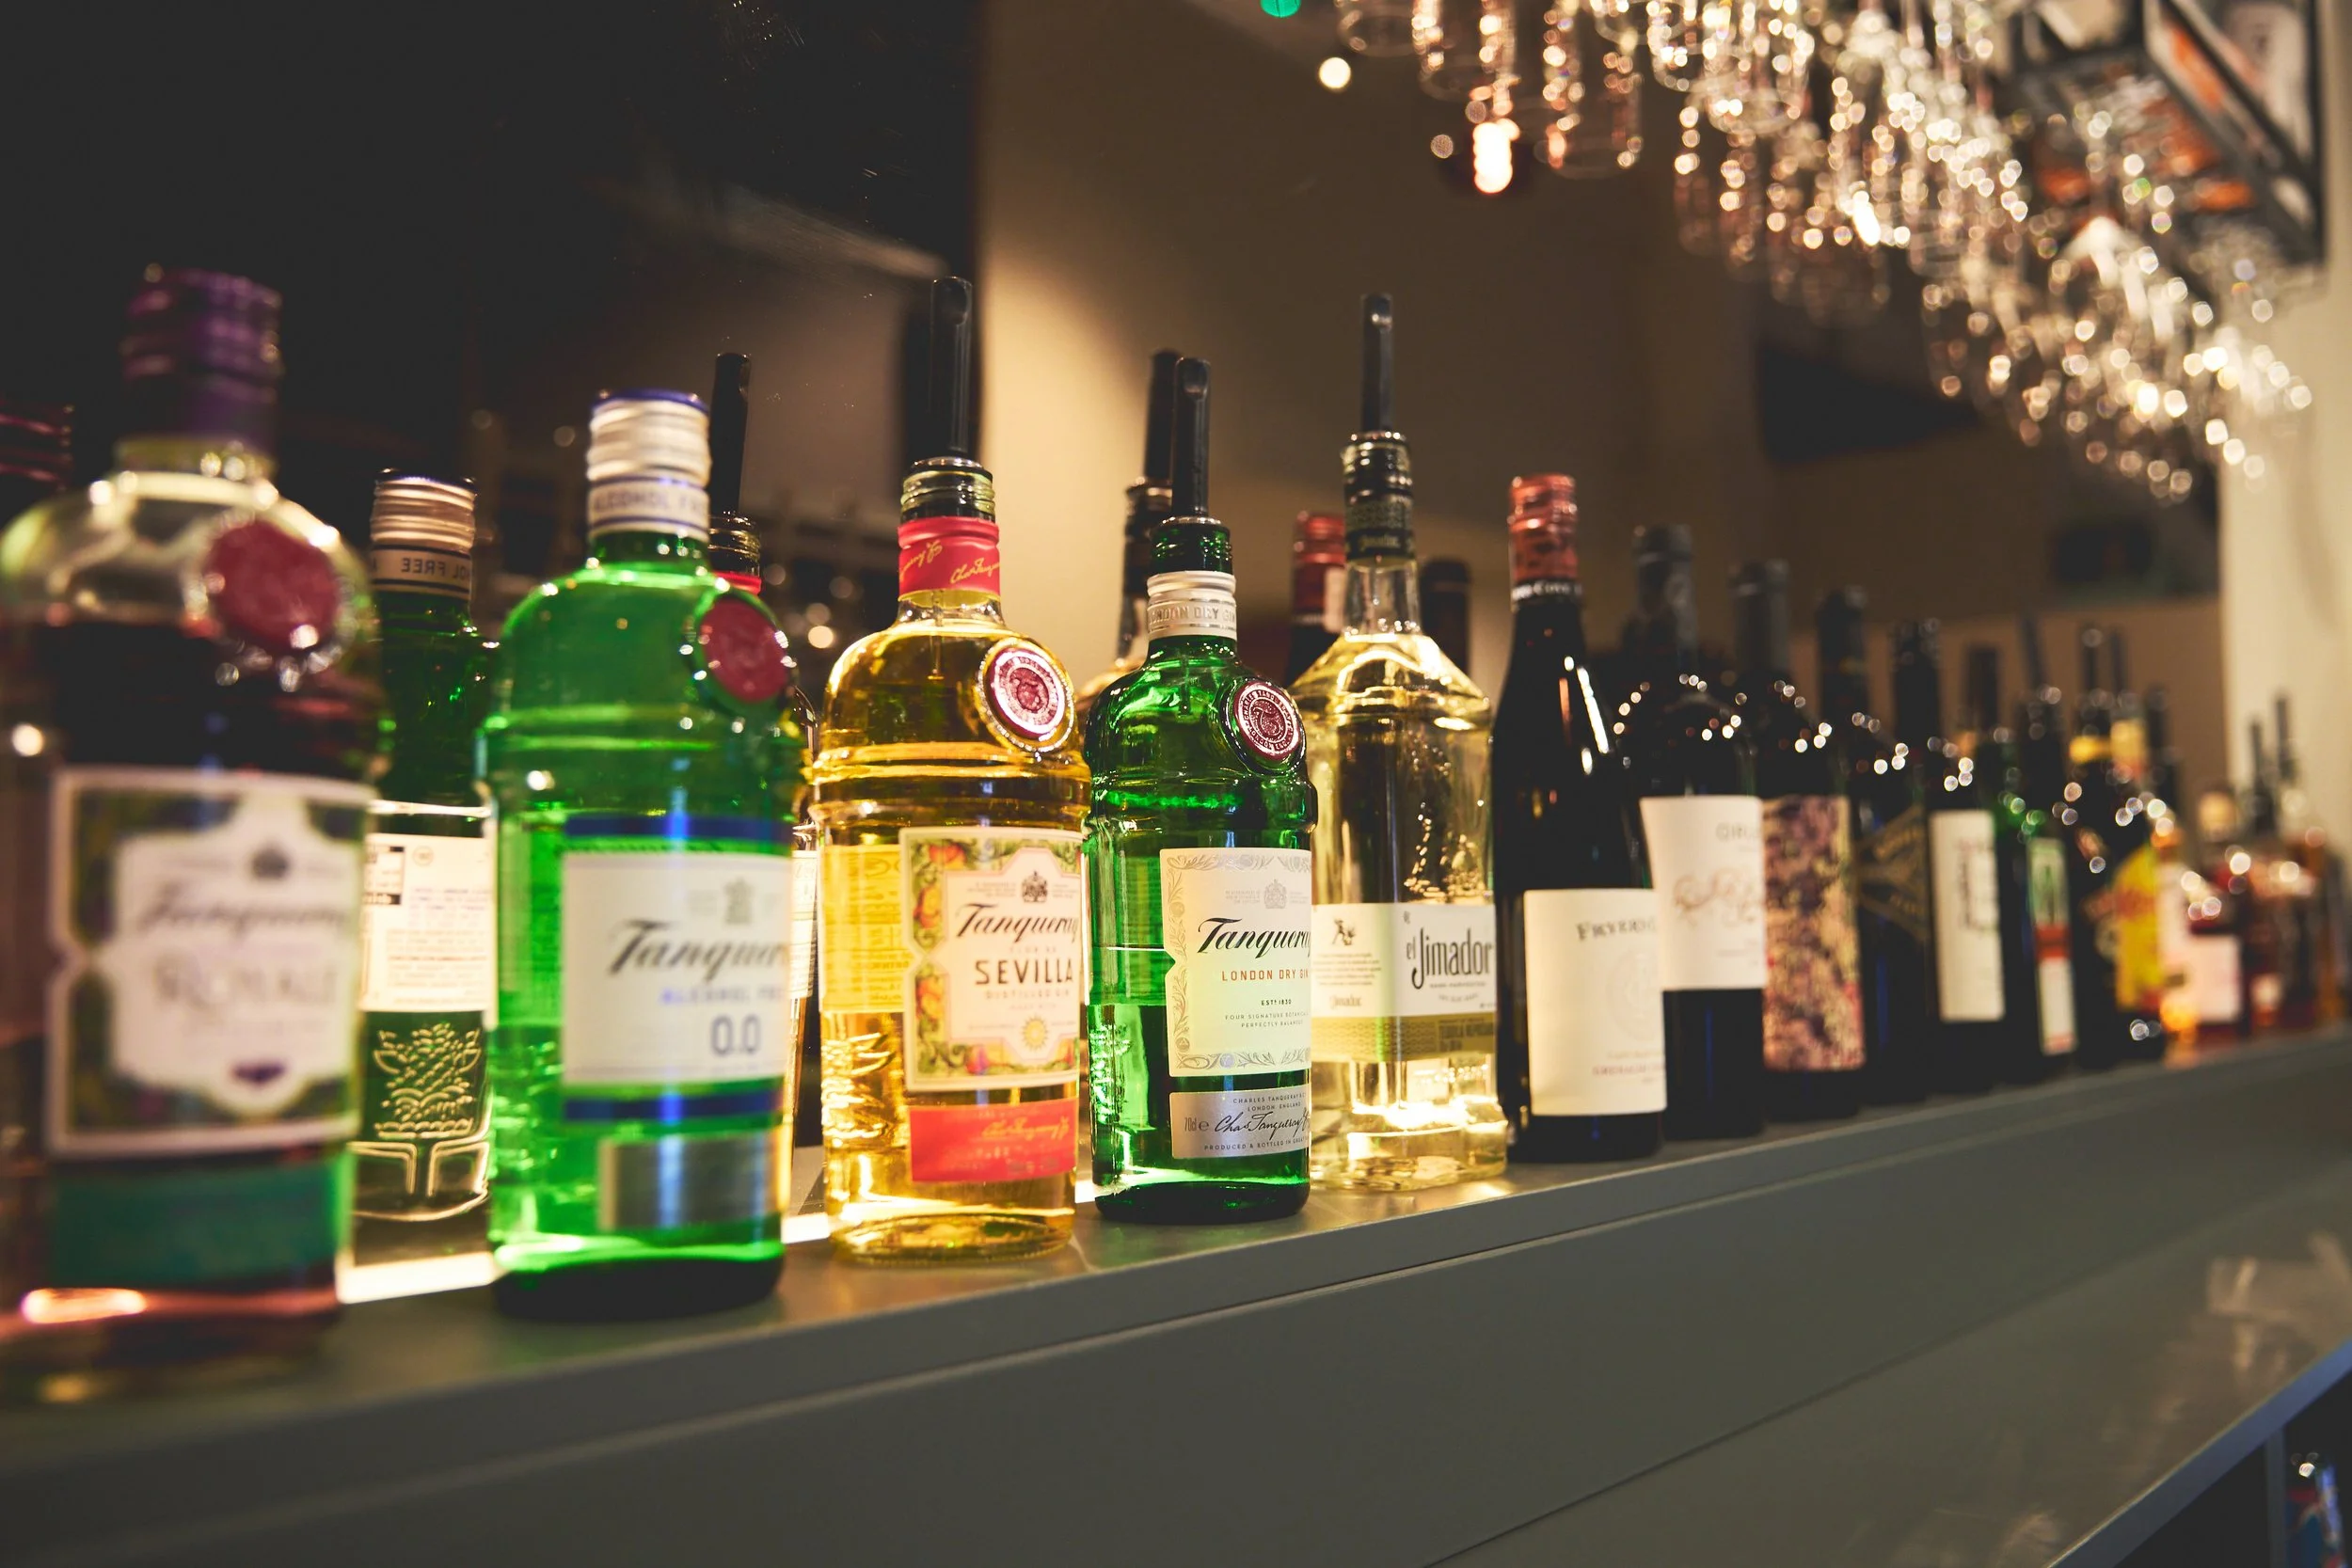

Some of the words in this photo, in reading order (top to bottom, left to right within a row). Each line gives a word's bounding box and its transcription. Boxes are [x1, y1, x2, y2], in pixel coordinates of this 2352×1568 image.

[1194, 605, 1219, 620] DRY
[956, 903, 1080, 943] Tanqueray
[1406, 935, 1416, 959] el
[1411, 927, 1494, 990] Jimador
[975, 958, 1074, 985] SEVILLA
[1221, 970, 1273, 981] LONDON
[1279, 969, 1296, 979] DRY
[1257, 1140, 1284, 1148] BOTTLED
